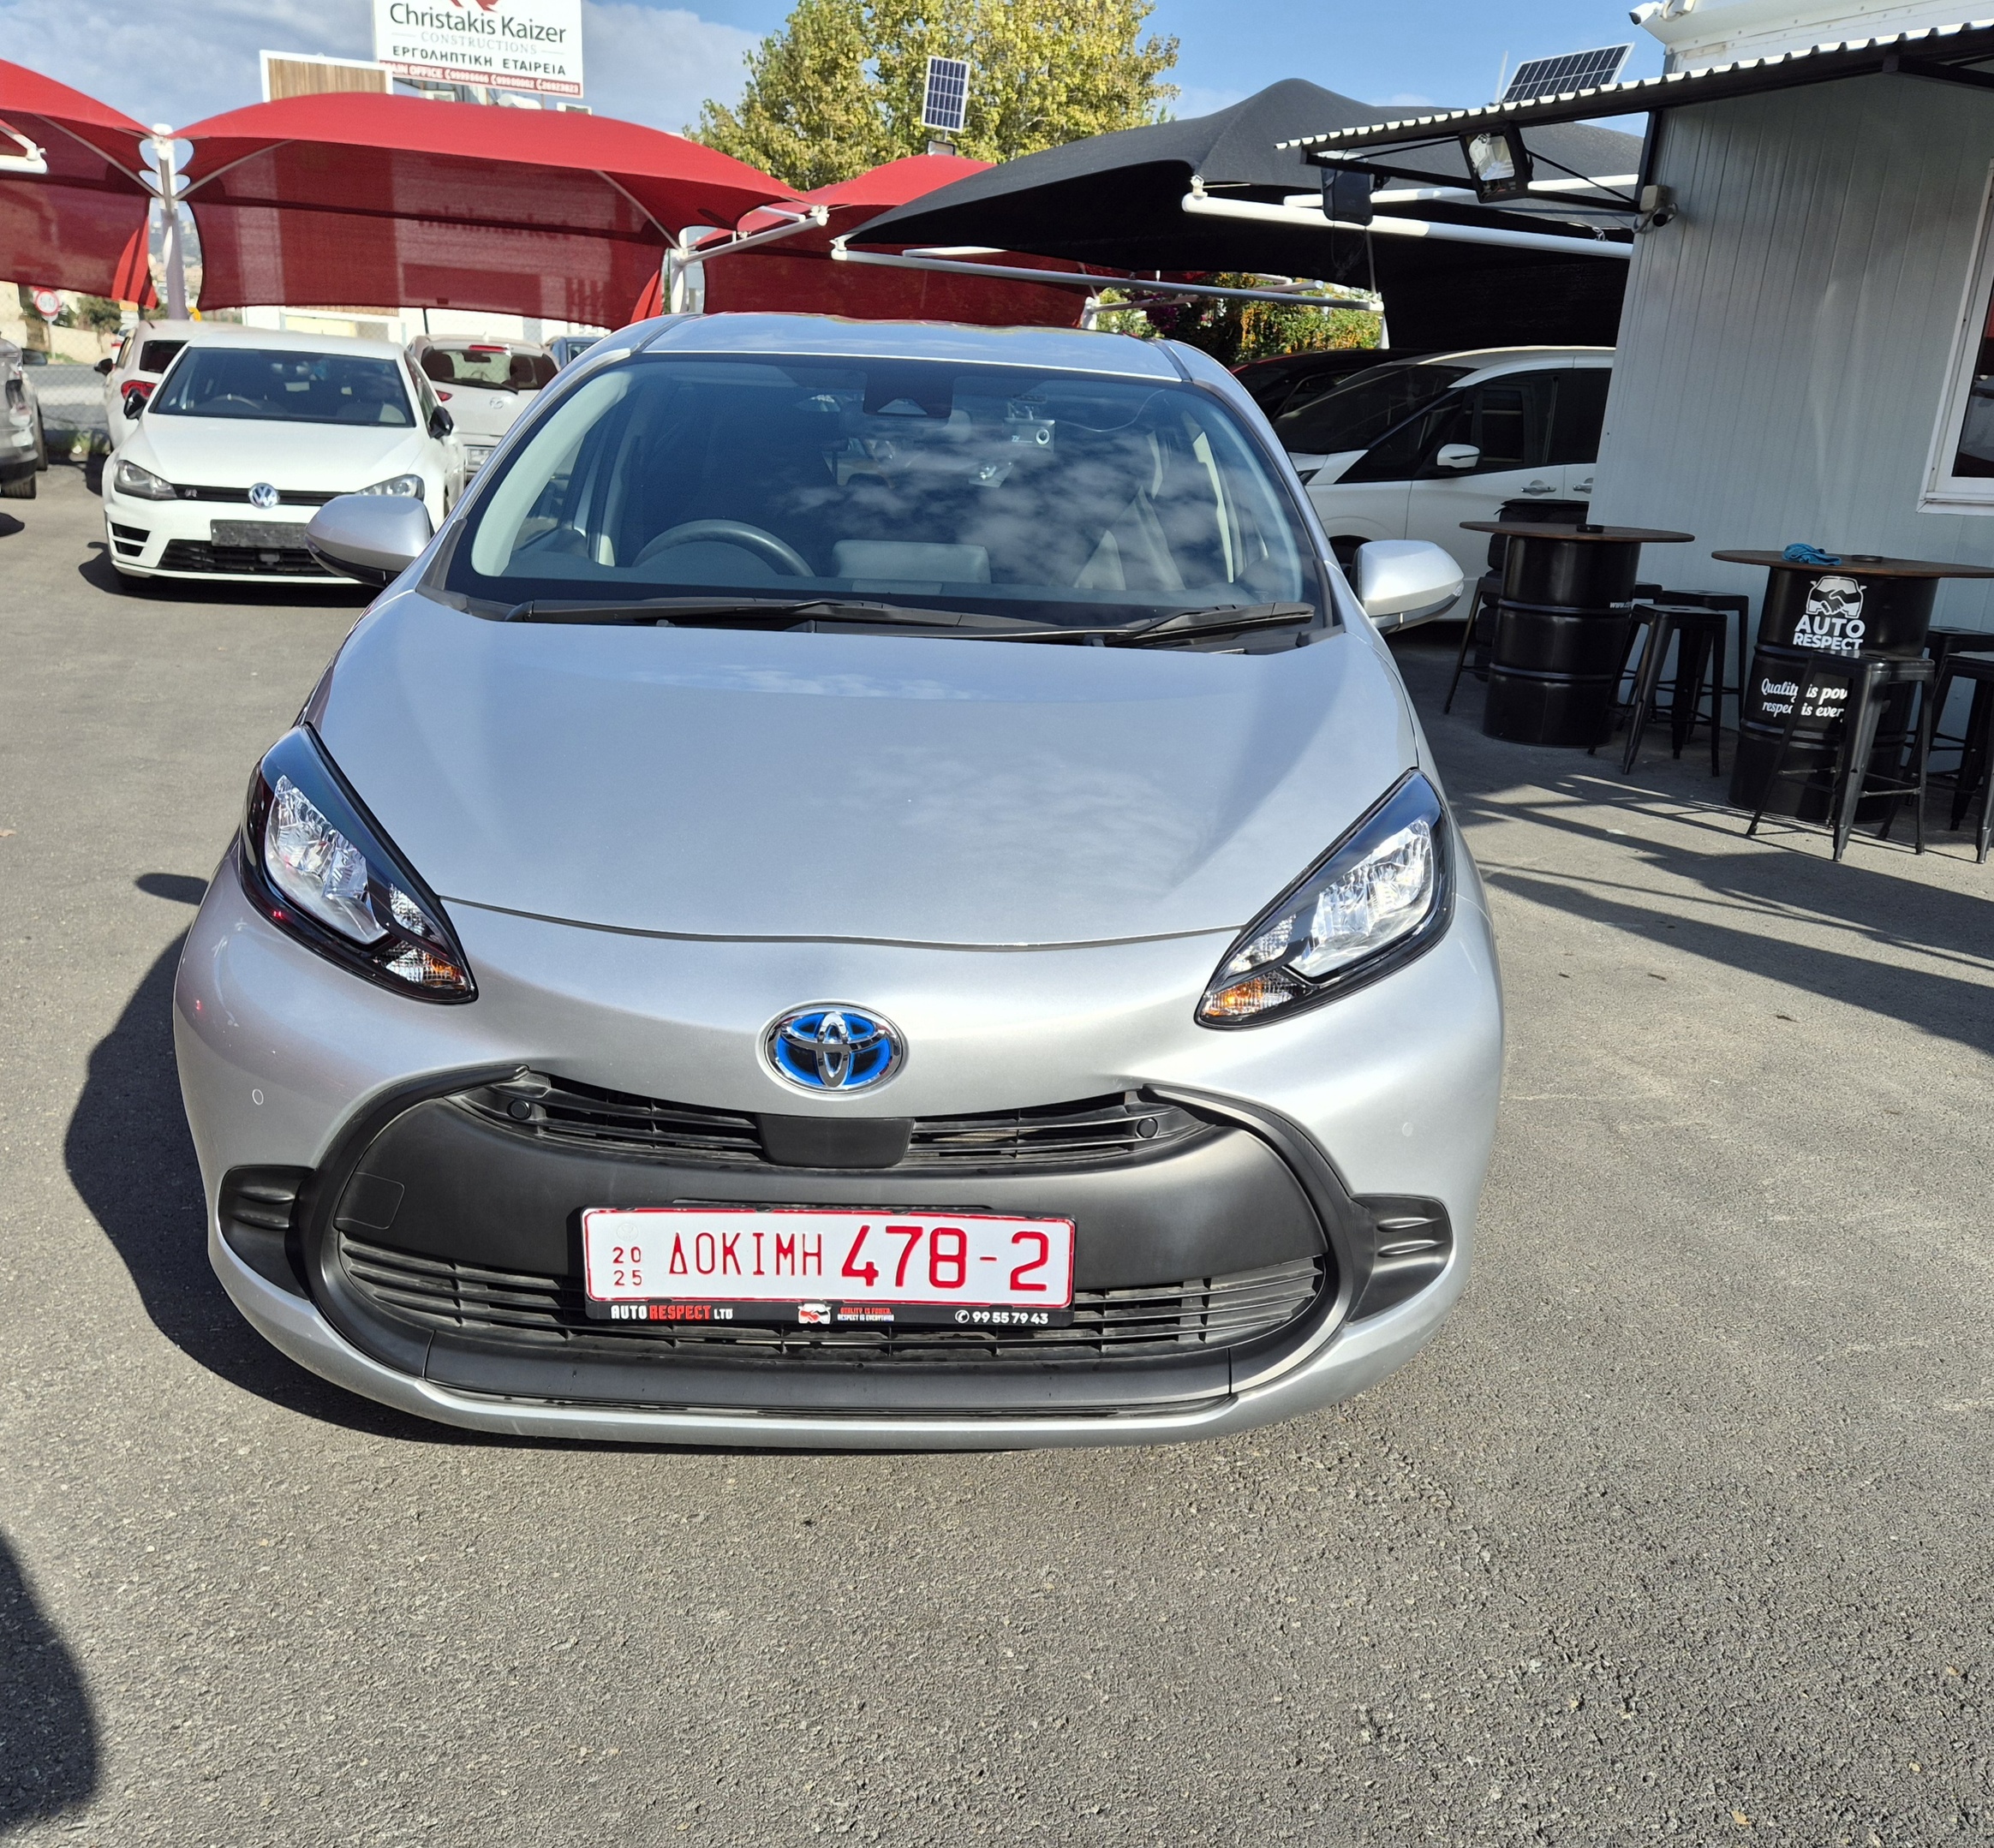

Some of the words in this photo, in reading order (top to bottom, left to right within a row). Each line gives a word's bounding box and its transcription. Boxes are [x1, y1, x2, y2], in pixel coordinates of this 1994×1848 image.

[390, 3, 496, 35] Christakis
[502, 15, 566, 43] Kaizer
[421, 31, 537, 55] CONSTRUCTIONS
[392, 45, 493, 67] ΕΡΓΟΛΗΠΤΙΚΗ
[503, 58, 566, 75] ΕΤΑΙΡΕΙΑ
[409, 65, 444, 78] OFFICE
[1794, 614, 1866, 638] AUTO
[1793, 632, 1864, 650] RESPECT
[1806, 683, 1818, 698] is
[1800, 702, 1813, 716] is
[1816, 706, 1844, 723] ever
[612, 1246, 642, 1264] 20
[668, 1231, 822, 1277] ΔΟΚΙΜΗ
[841, 1225, 1049, 1291] 478-2
[613, 1270, 642, 1286] 25
[713, 1309, 733, 1320] LTD
[972, 1311, 990, 1323] 99
[992, 1311, 1010, 1324] 55
[1011, 1312, 1029, 1324] 79
[1030, 1313, 1049, 1325] 43
